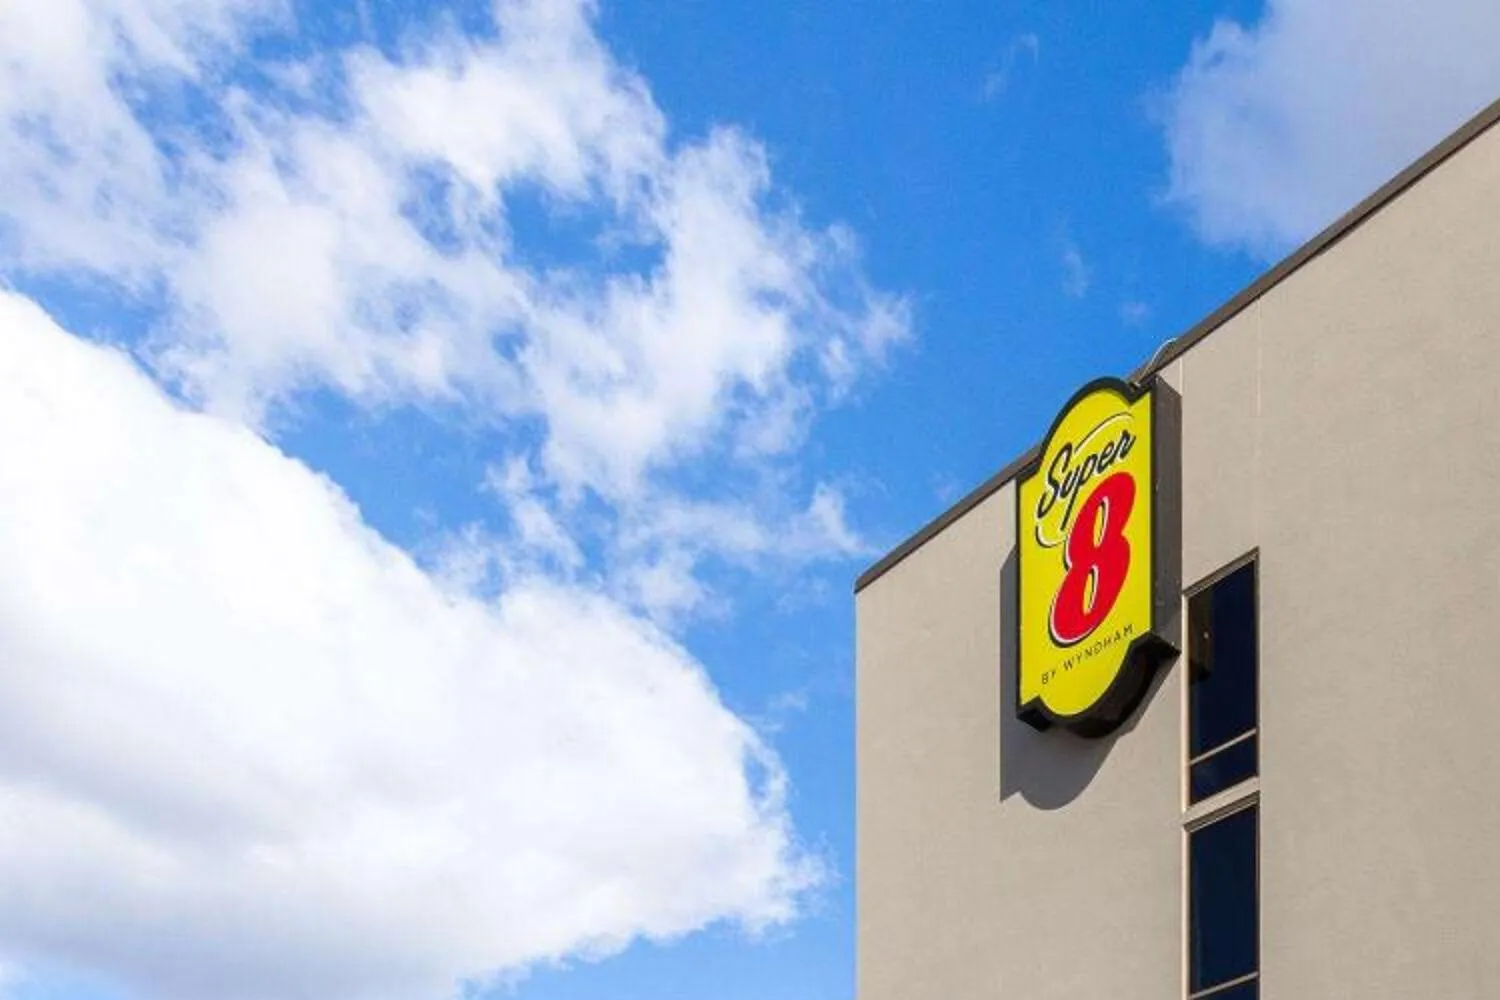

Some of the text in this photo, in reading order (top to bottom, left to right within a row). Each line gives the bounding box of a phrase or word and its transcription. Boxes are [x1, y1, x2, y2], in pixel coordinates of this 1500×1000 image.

[1037, 429, 1136, 532] Super
[1049, 471, 1136, 648] 8
[1041, 623, 1134, 685] BY WYNDHAM
